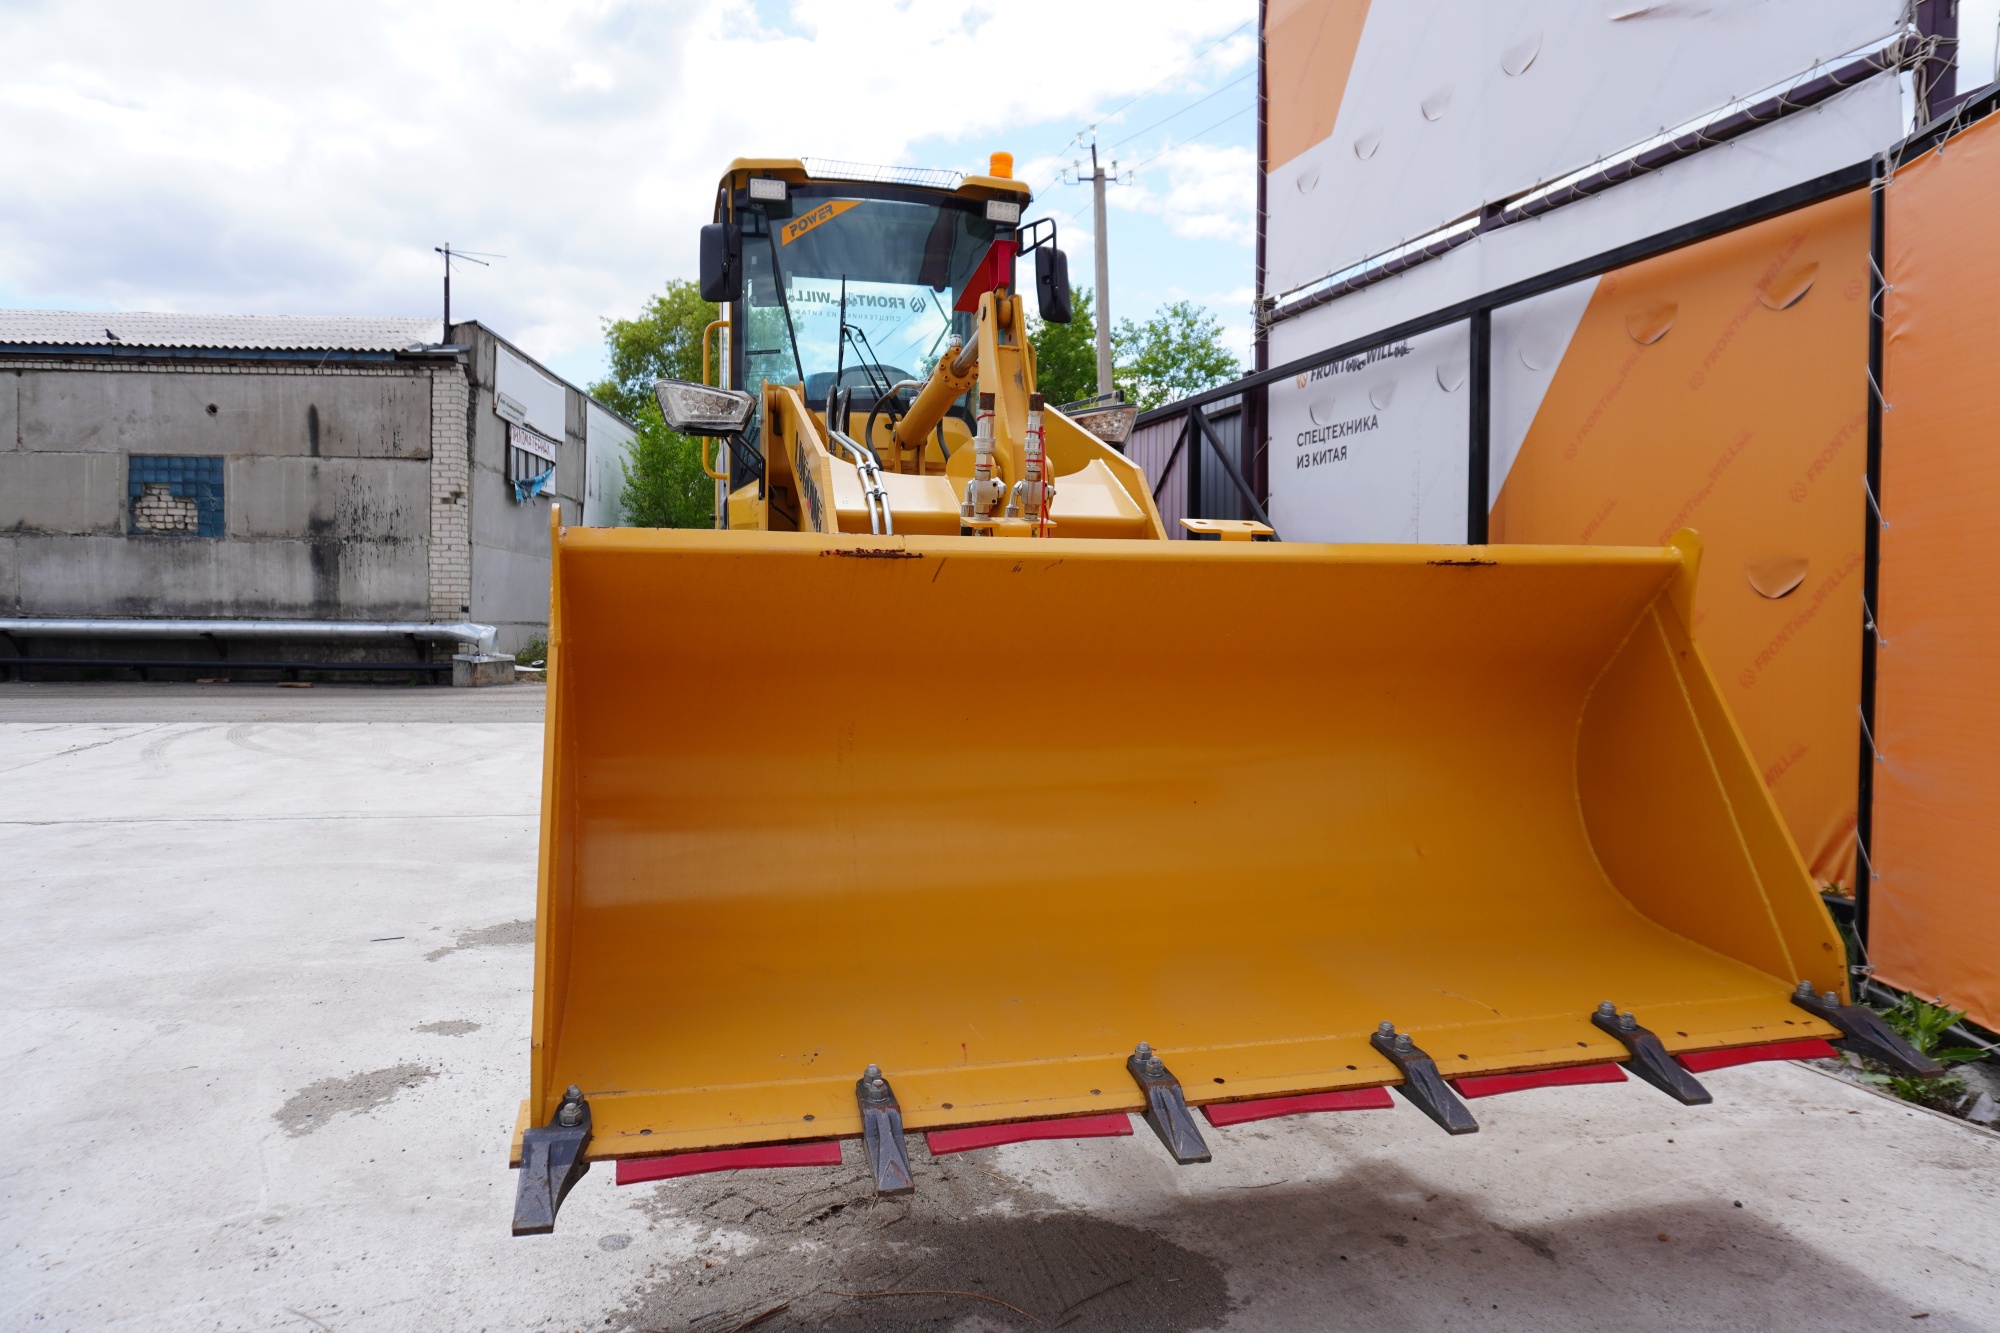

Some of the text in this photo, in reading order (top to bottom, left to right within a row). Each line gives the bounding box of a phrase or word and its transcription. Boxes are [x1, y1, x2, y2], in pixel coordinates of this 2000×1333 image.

[789, 203, 834, 237] POWER
[1310, 343, 1394, 382] FRONT WILL
[1296, 414, 1379, 447] СПЕЦТЕХНИКА
[1296, 445, 1348, 469] ИЗ КИТАЯ
[1754, 620, 1797, 671] FRONT
